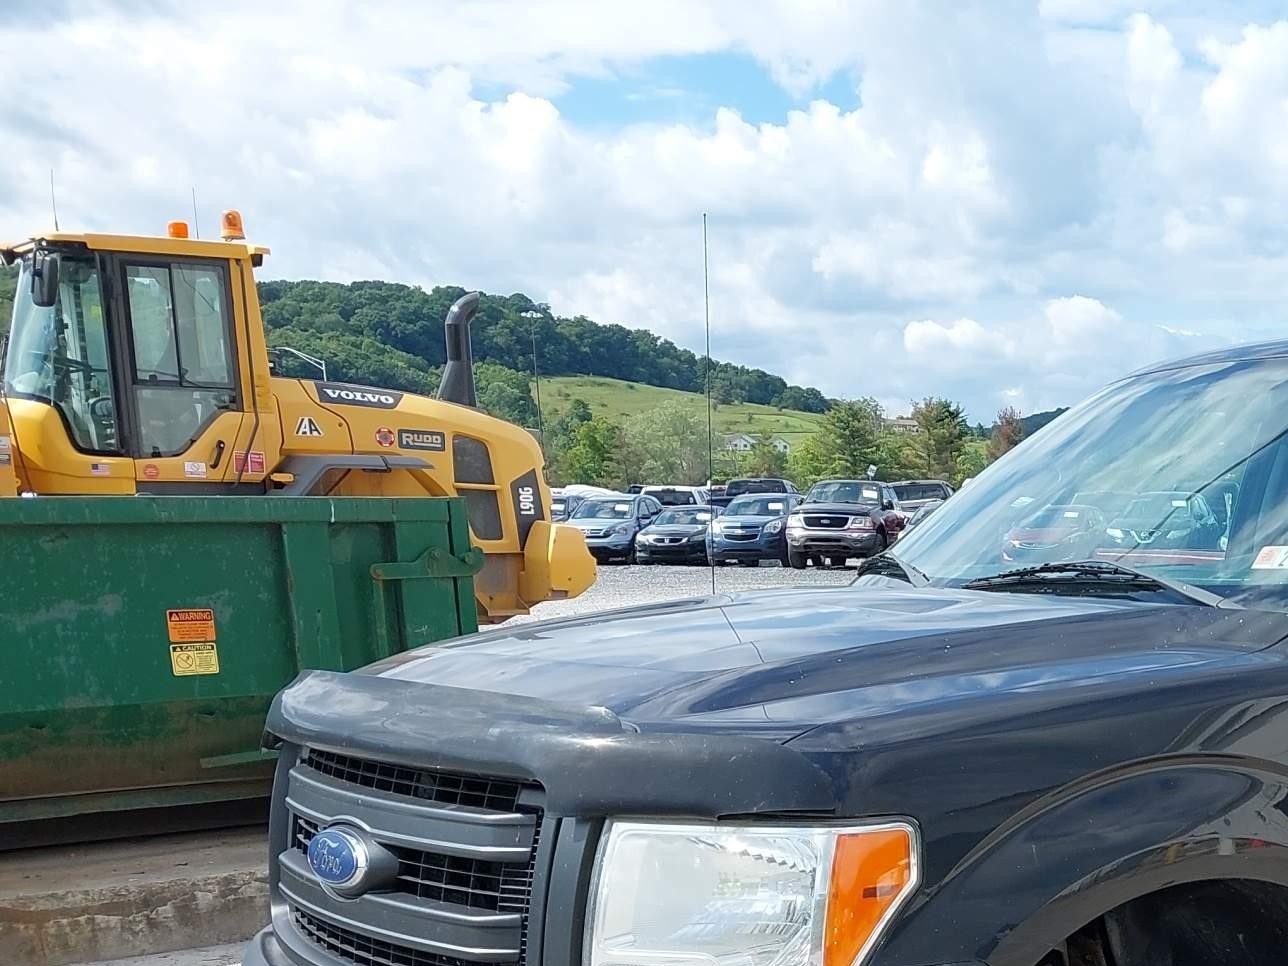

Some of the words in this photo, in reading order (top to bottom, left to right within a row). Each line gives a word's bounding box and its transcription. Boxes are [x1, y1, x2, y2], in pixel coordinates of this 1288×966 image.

[323, 388, 394, 404] VOLVO
[402, 433, 441, 447] RUDD
[519, 486, 535, 515] L90G
[178, 612, 211, 621] WARNING
[312, 837, 348, 876] Ford
